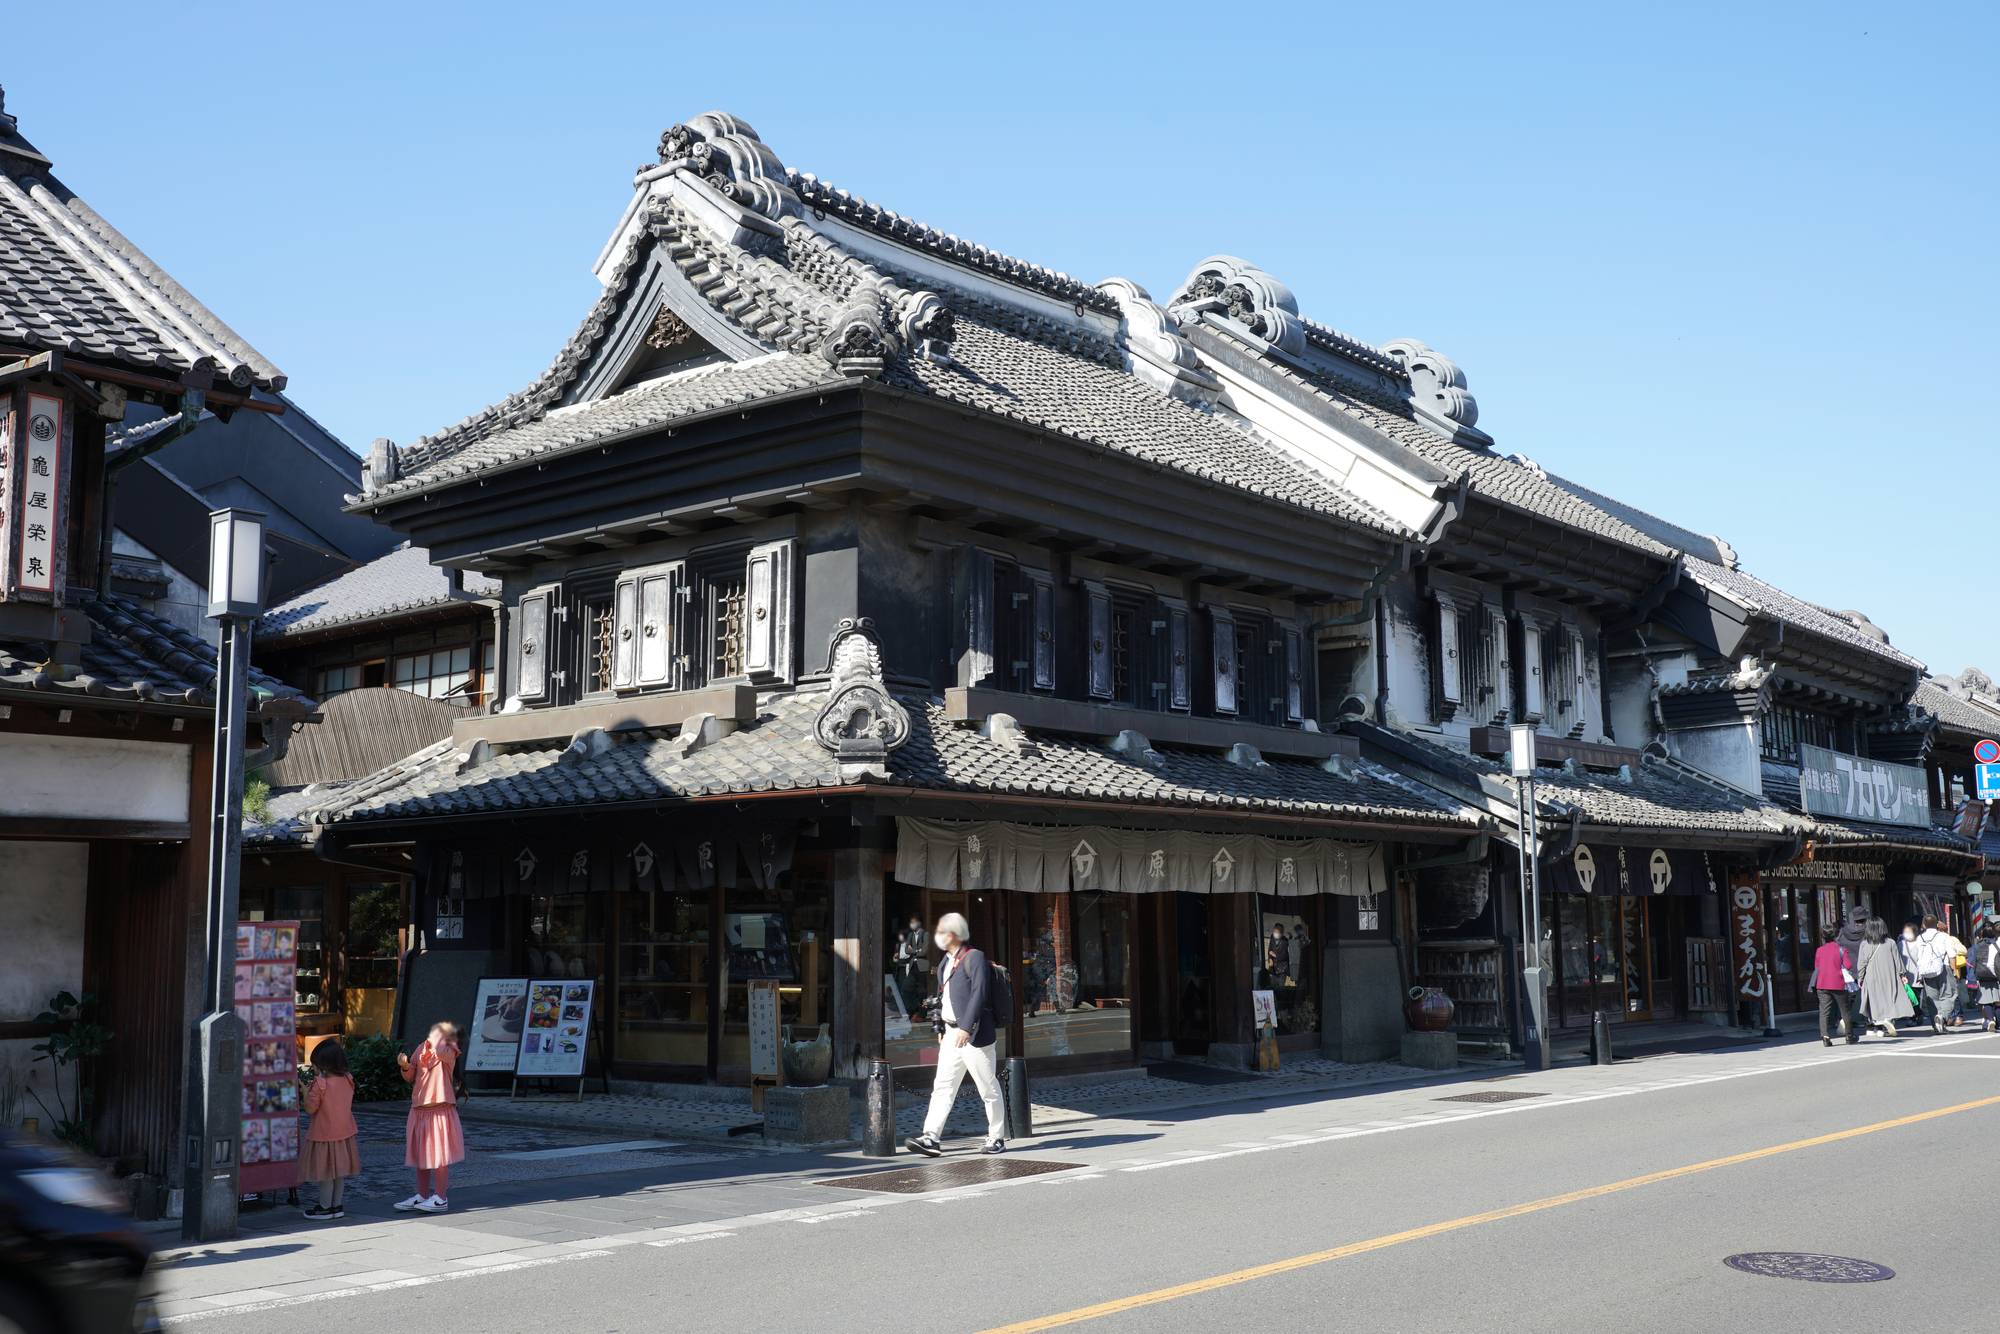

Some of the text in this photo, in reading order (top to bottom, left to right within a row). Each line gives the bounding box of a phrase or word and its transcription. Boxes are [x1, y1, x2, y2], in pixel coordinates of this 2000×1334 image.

[1835, 756, 1901, 822] フカゼン
[570, 849, 588, 876] 原
[697, 840, 713, 870] 原
[1148, 849, 1166, 878] 原
[1279, 856, 1296, 884] 原
[1737, 914, 1764, 998] まちかん
